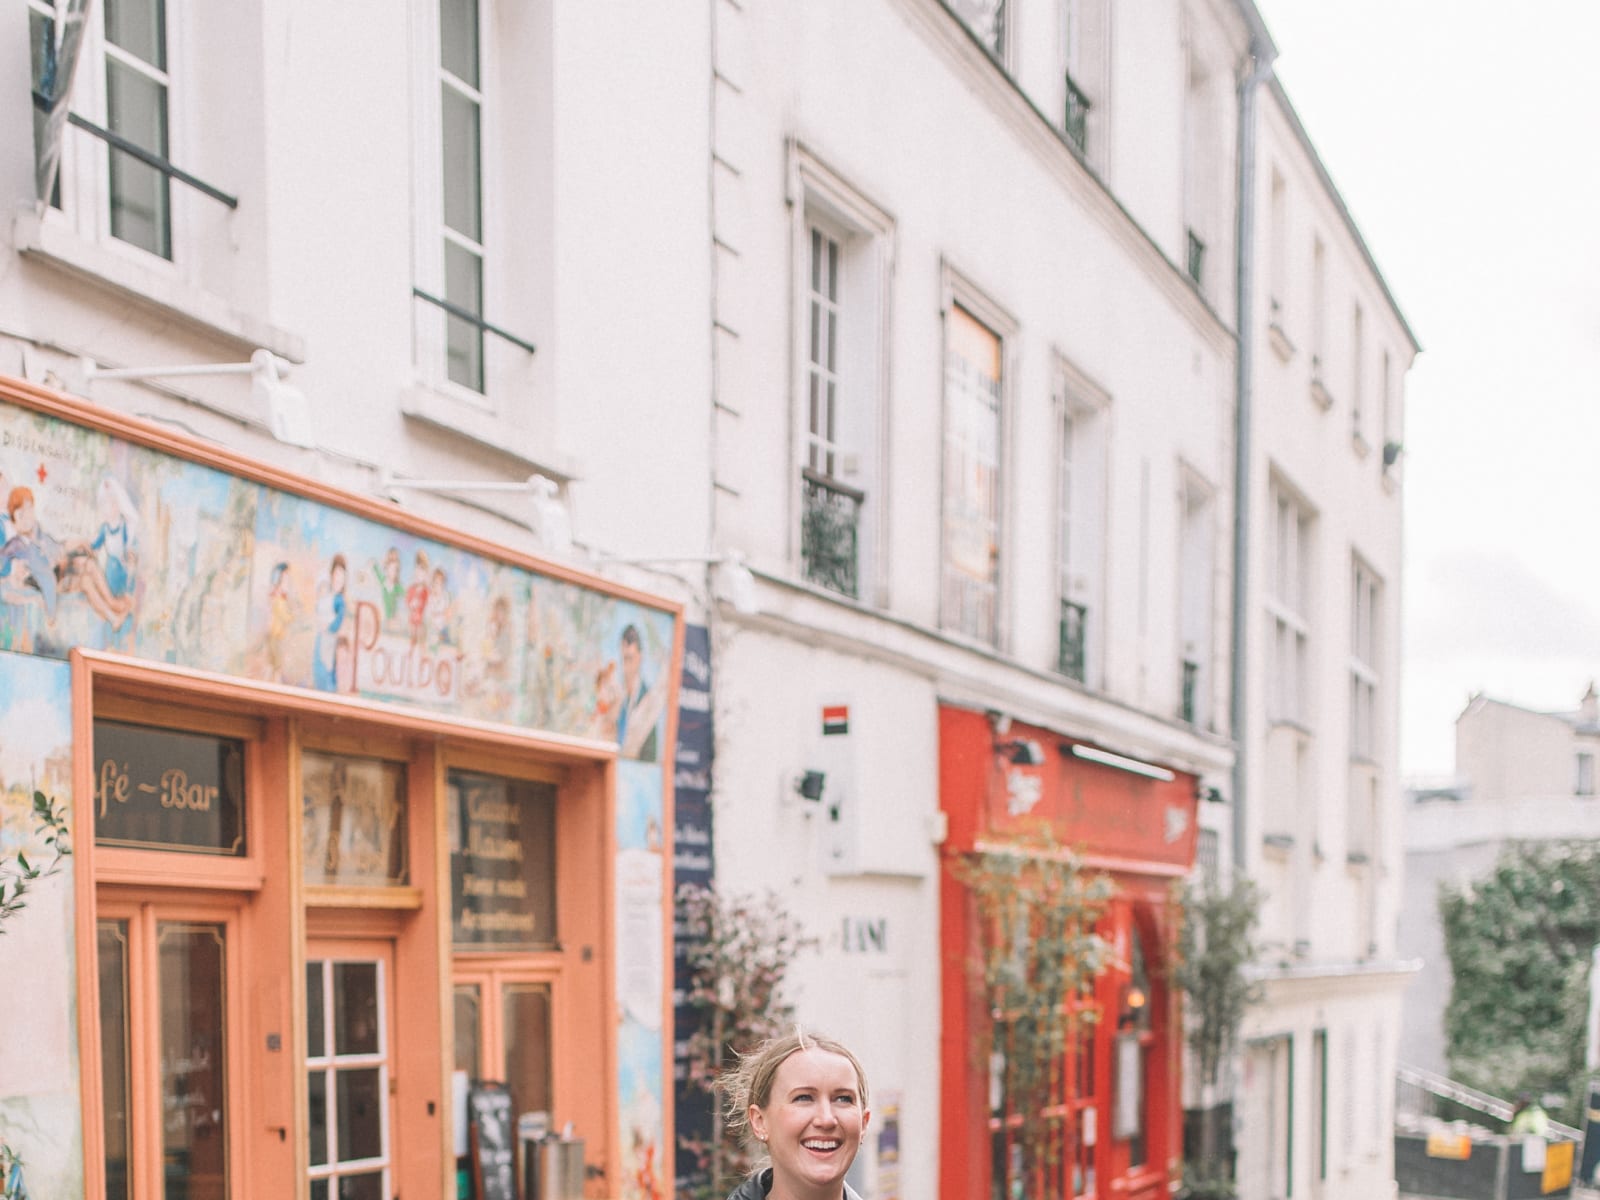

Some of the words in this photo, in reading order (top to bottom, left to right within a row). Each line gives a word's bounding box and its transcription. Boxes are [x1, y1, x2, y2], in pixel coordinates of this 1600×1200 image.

[349, 600, 467, 698] Poulbot
[94, 759, 131, 818] fé
[160, 768, 219, 812] Bar
